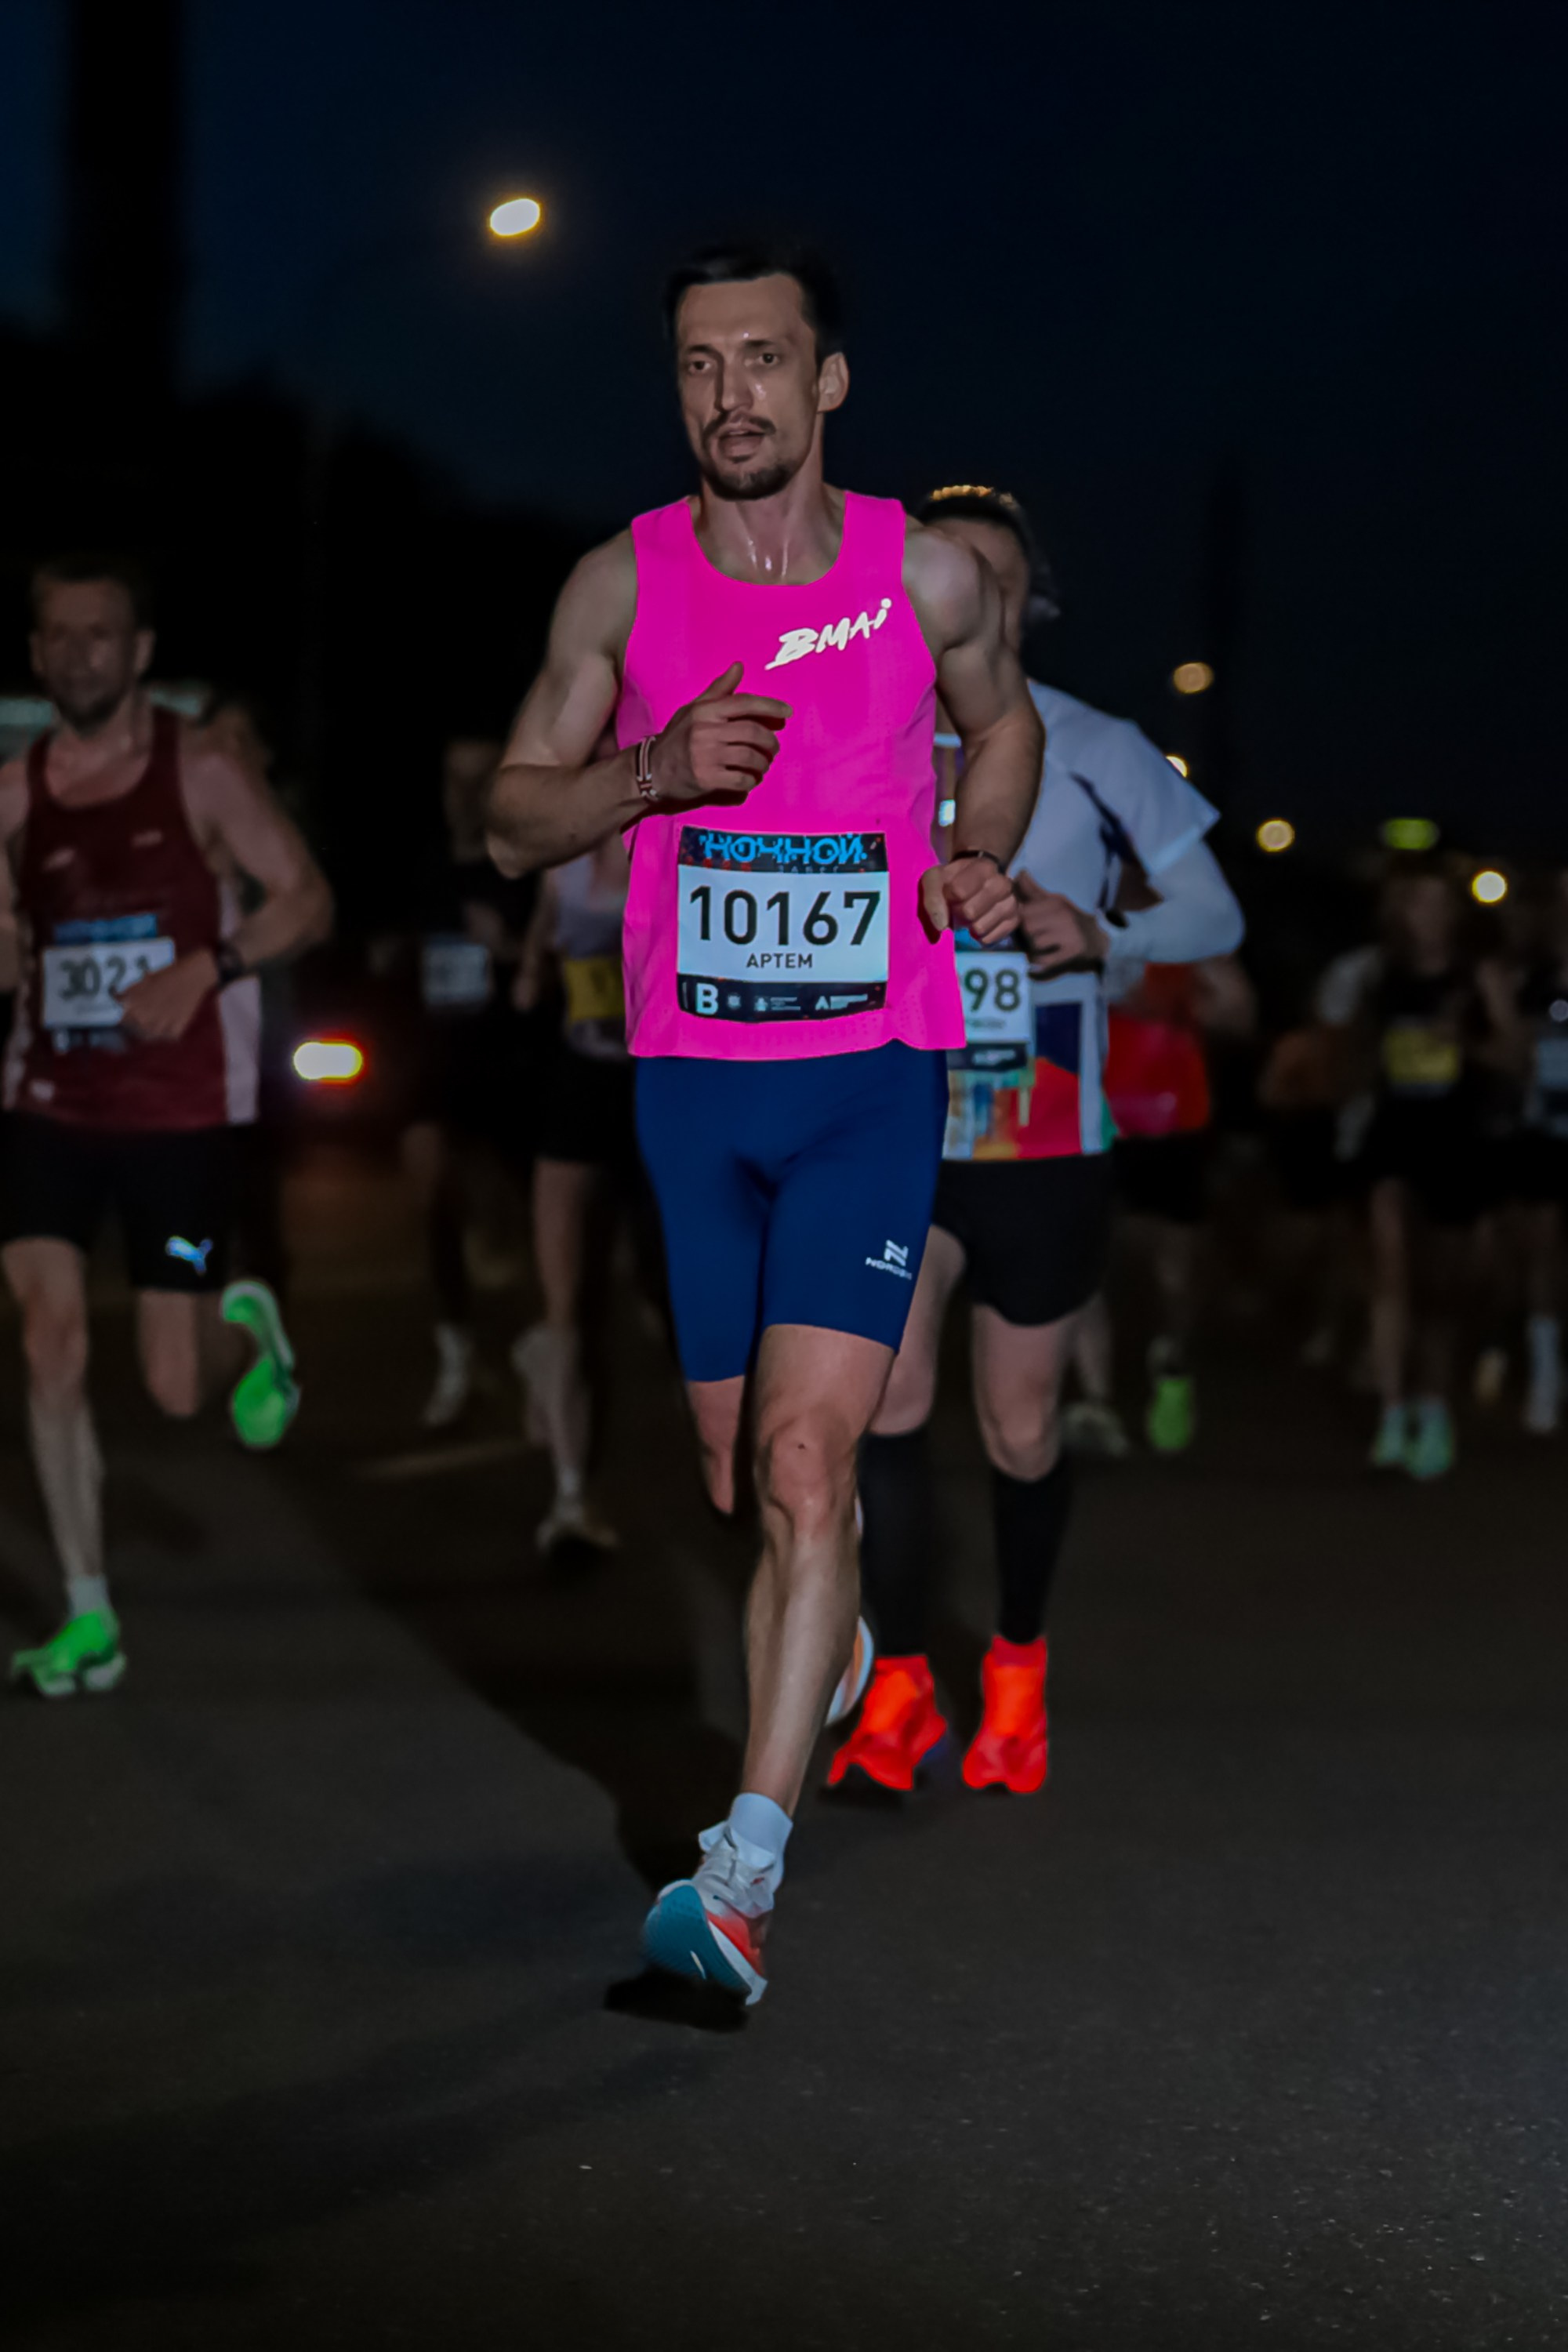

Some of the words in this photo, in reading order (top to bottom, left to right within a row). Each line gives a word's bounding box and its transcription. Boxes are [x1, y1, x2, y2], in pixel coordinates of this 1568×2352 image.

[690, 886, 880, 946] 10167
[746, 953, 813, 969] АРТЕМ
[964, 969, 1020, 1011] 98
